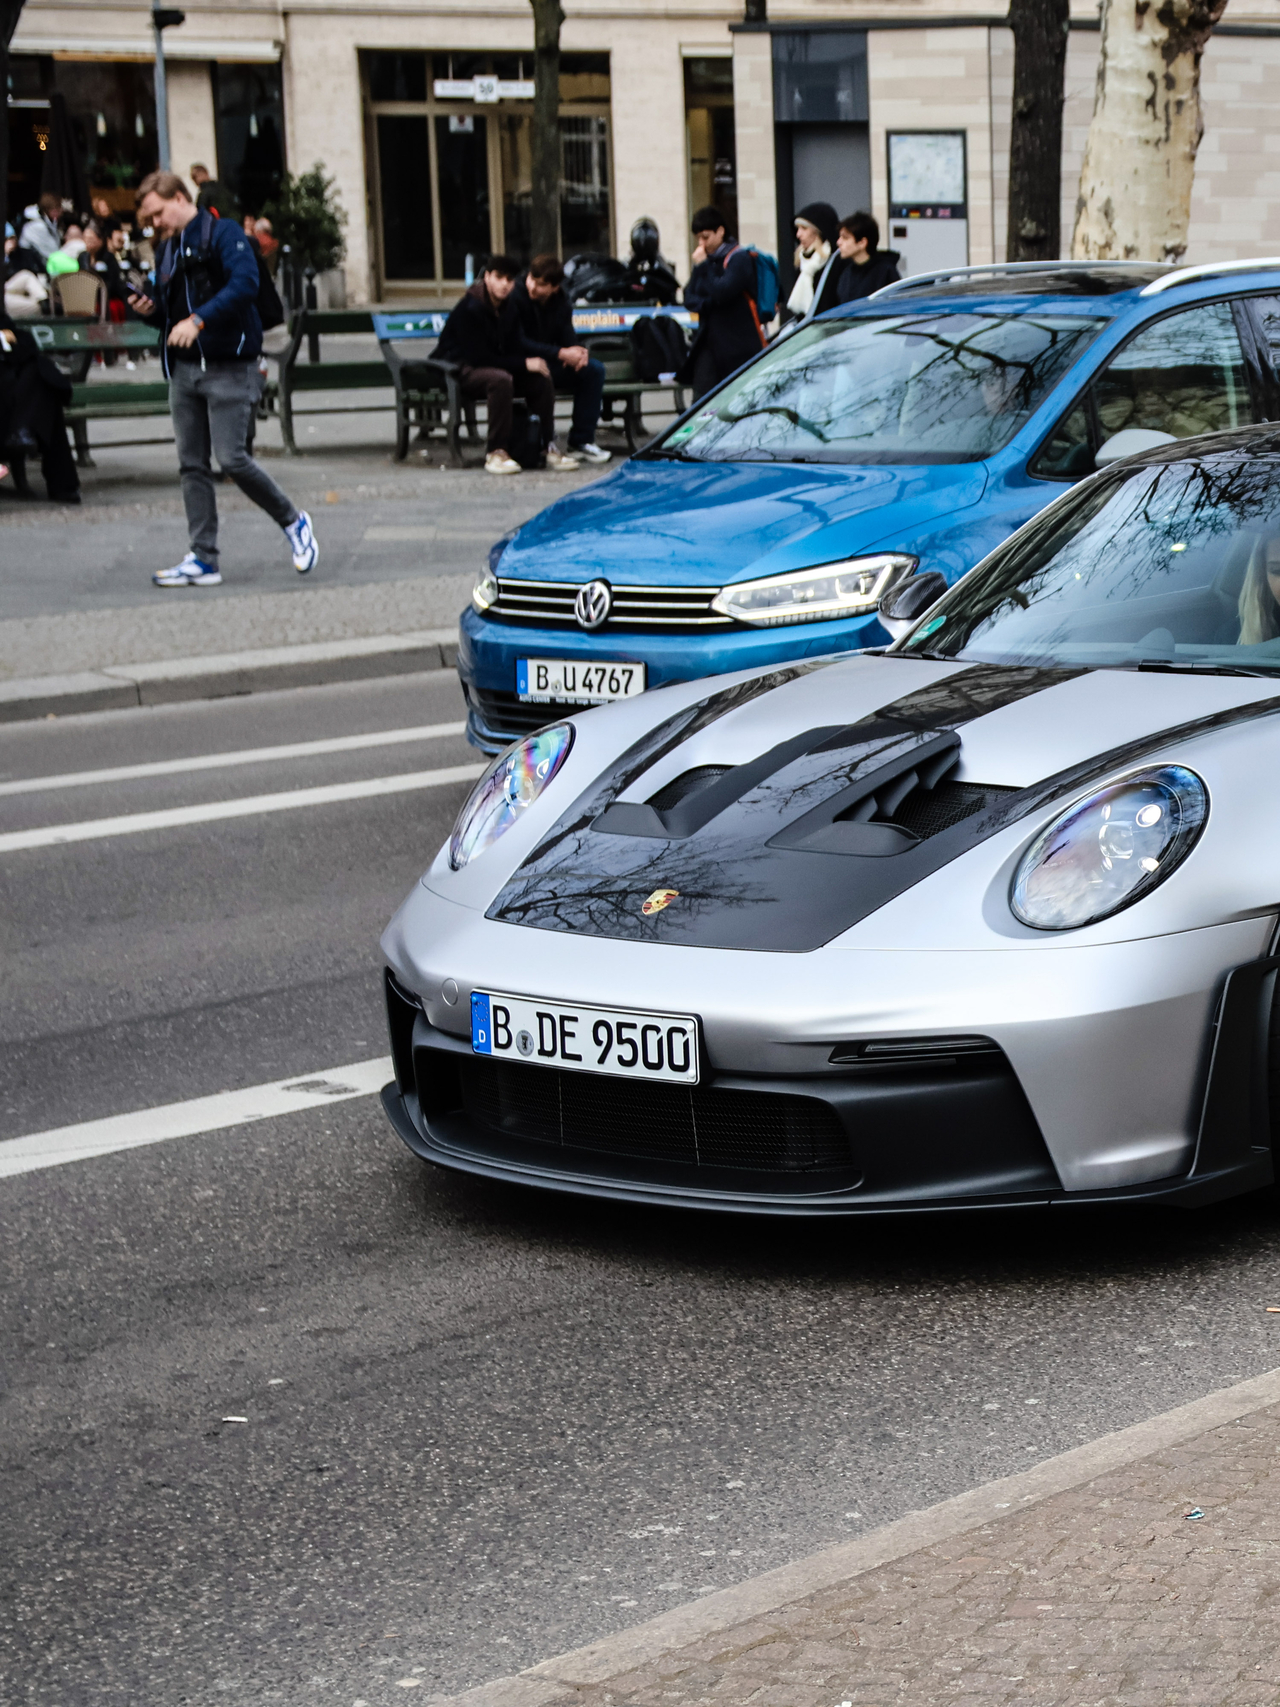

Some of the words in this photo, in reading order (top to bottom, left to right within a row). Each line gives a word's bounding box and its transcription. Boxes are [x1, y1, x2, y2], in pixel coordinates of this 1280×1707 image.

[572, 310, 619, 331] omplain
[574, 581, 610, 628] VW
[537, 665, 549, 690] B
[563, 665, 577, 692] U
[582, 667, 634, 694] 4767
[478, 1029, 486, 1043] D
[492, 1004, 513, 1050] B
[536, 1011, 582, 1062] DE
[592, 1019, 690, 1072] 9500
